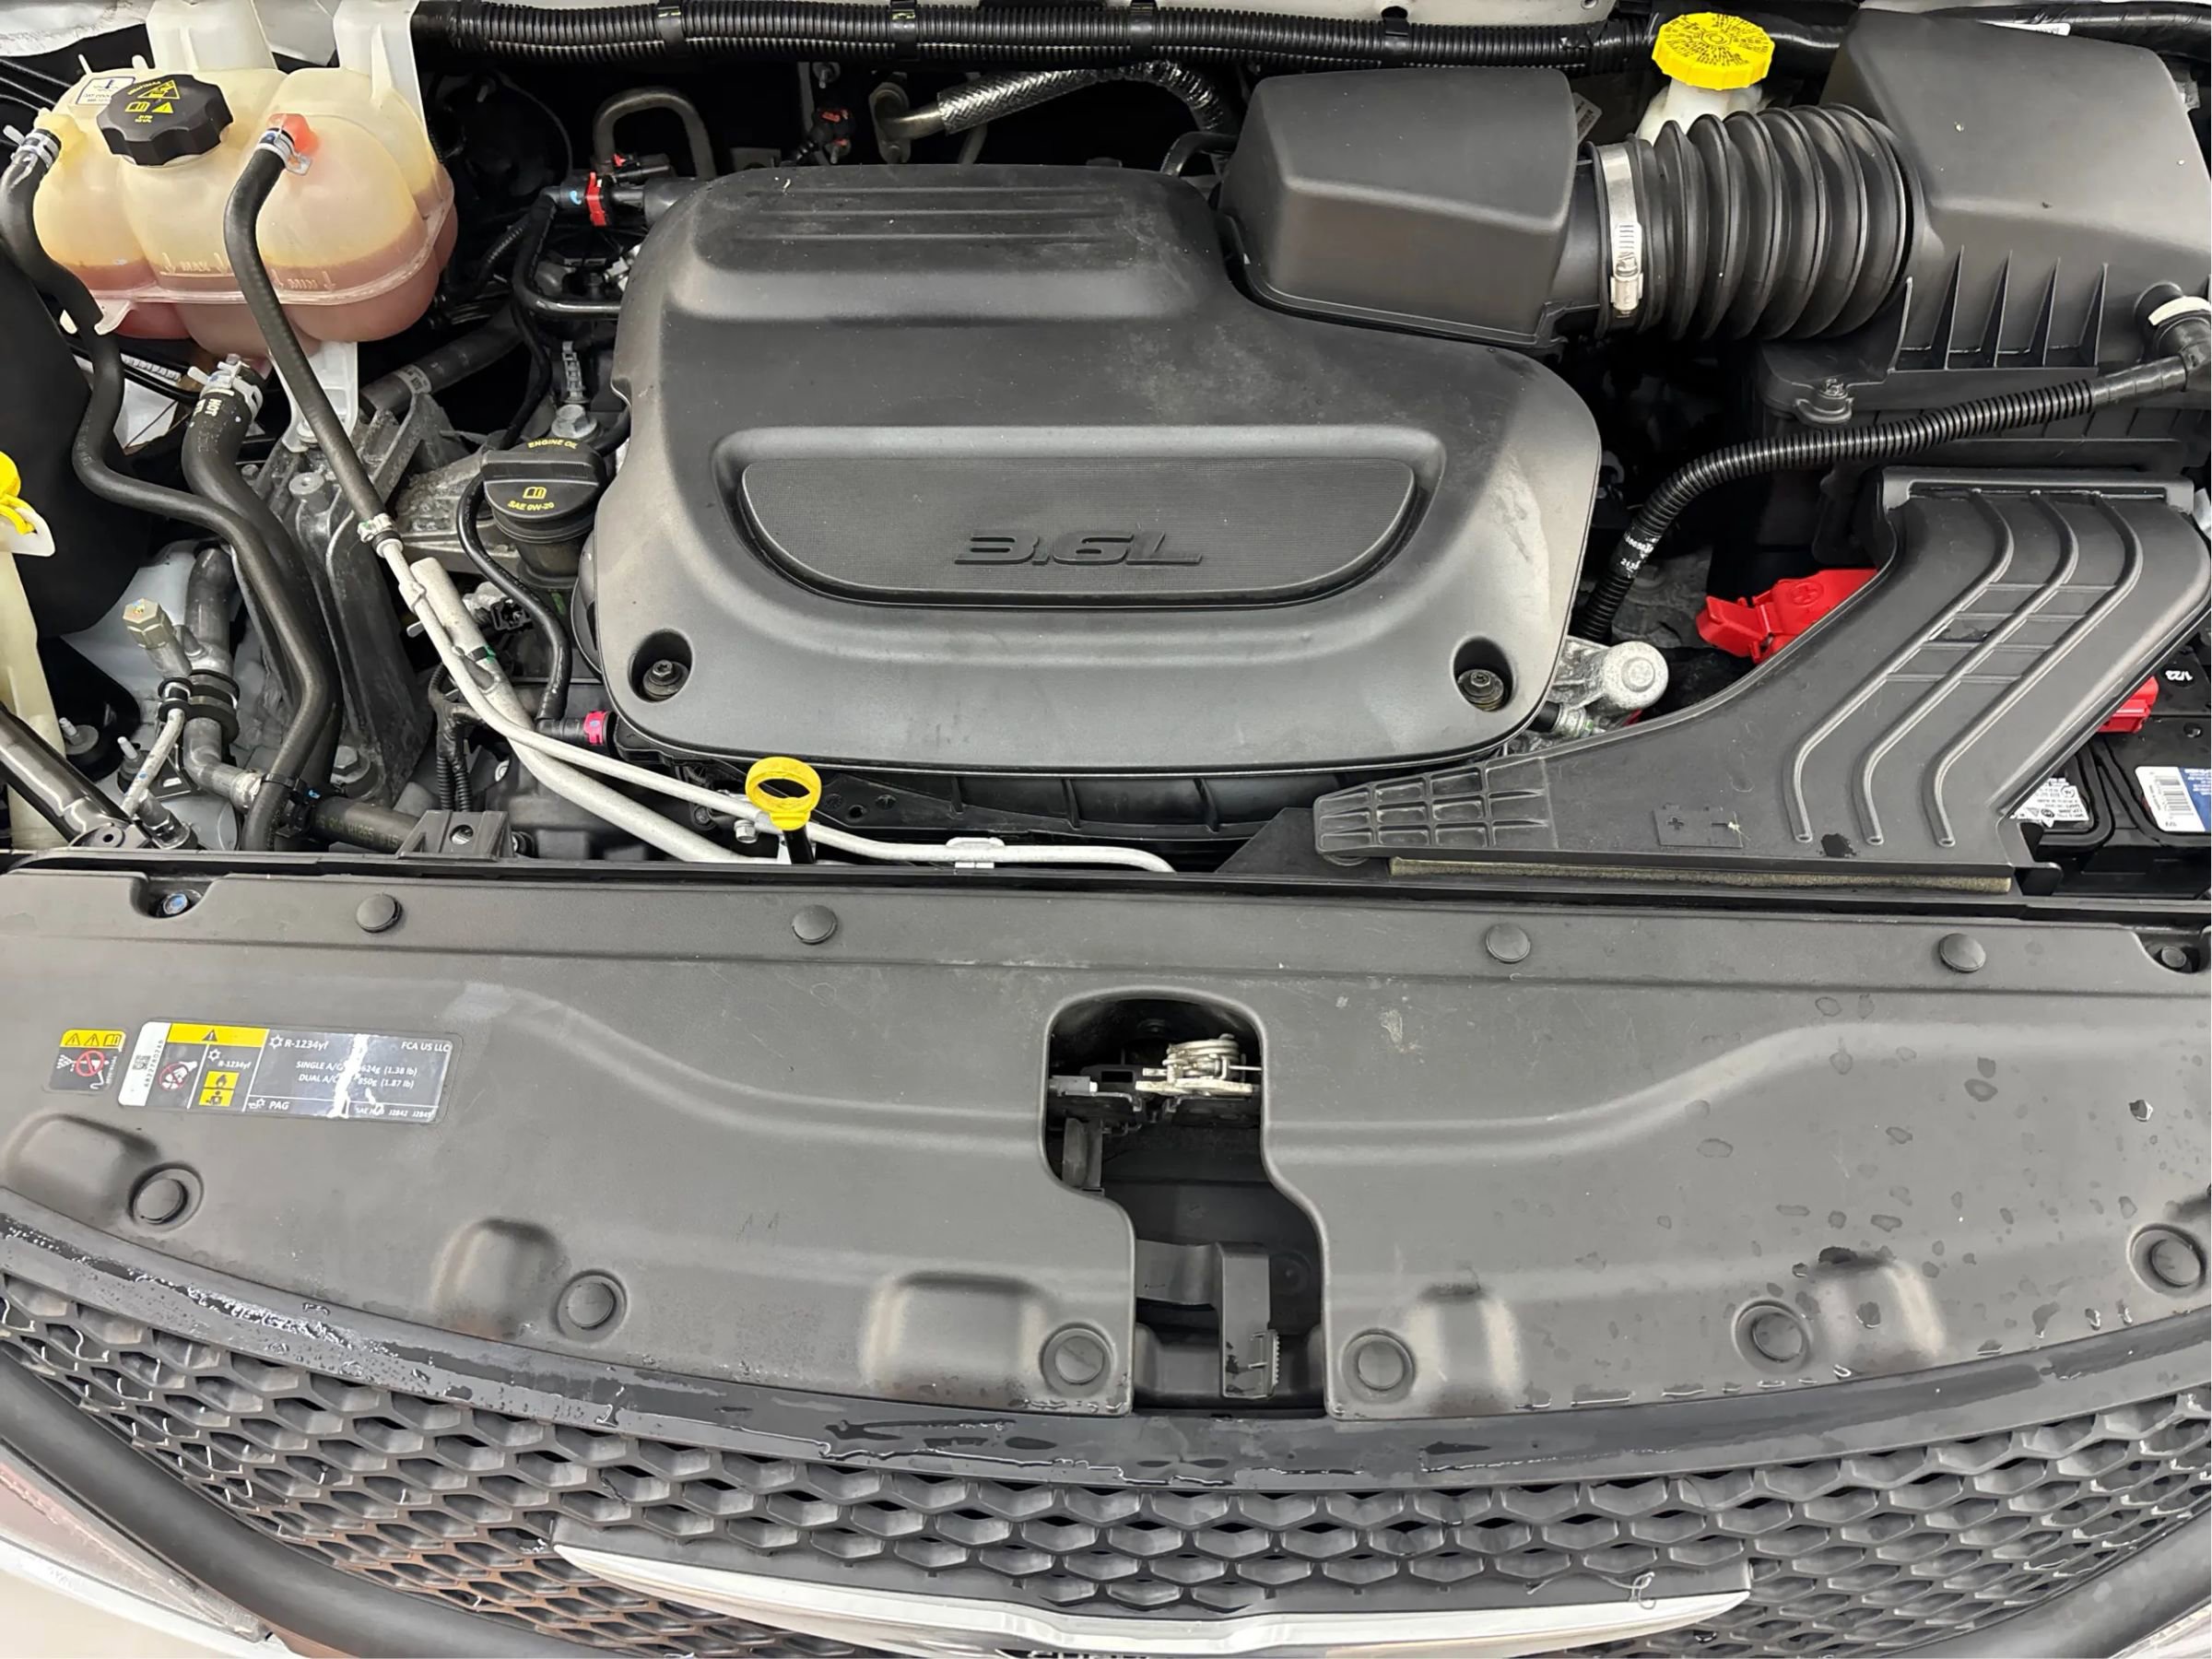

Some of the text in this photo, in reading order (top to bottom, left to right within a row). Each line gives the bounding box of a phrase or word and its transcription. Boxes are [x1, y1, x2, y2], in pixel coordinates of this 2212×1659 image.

[205, 398, 222, 417] HOT
[527, 439, 579, 450] ENGINE OIL
[507, 500, 555, 511] SAE 0W-20
[954, 529, 1203, 566] 3.6L
[284, 1039, 329, 1051] R-1234yf
[400, 1041, 451, 1053] FCA US LLC
[295, 1060, 325, 1070] SINGLE
[406, 1065, 418, 1077] lb)
[298, 1073, 321, 1083] DUAL
[402, 1079, 415, 1090] lb)
[268, 1100, 290, 1112] PAG
